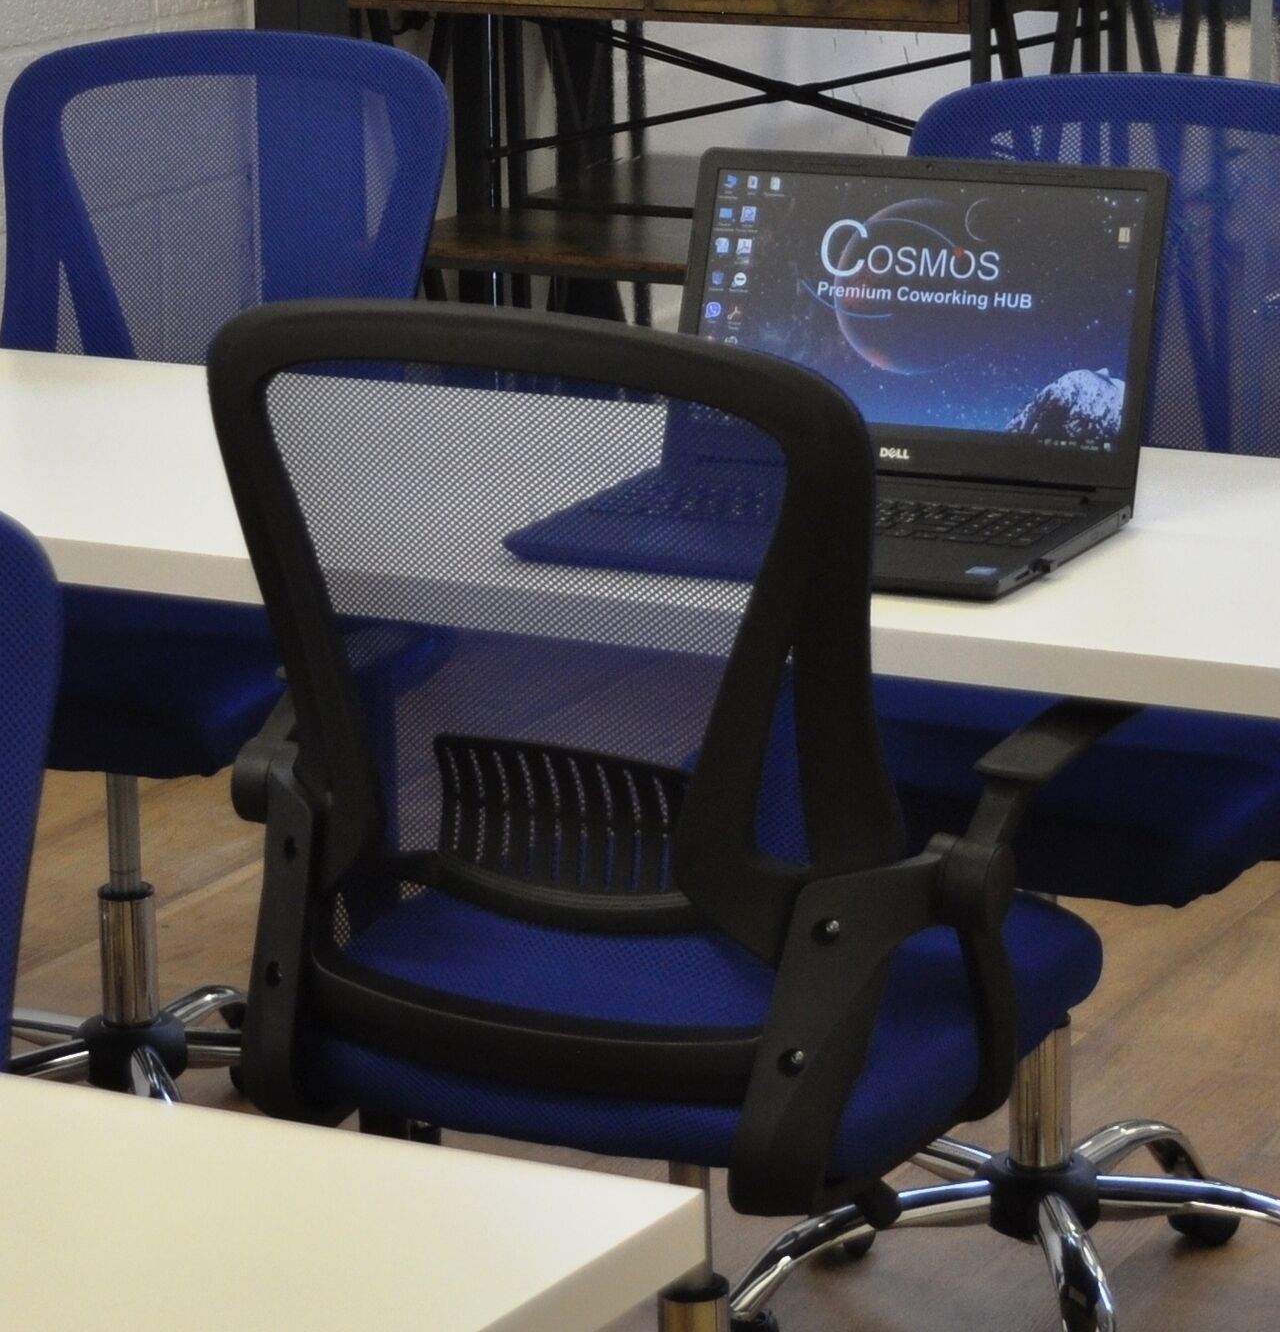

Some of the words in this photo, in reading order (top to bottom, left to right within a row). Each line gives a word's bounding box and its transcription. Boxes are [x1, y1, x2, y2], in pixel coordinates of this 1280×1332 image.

[821, 219, 1001, 281] COSMOS
[817, 281, 892, 300] Premium
[897, 285, 989, 310] Coworking
[993, 292, 1032, 309] HUB
[879, 447, 910, 459] DELL
